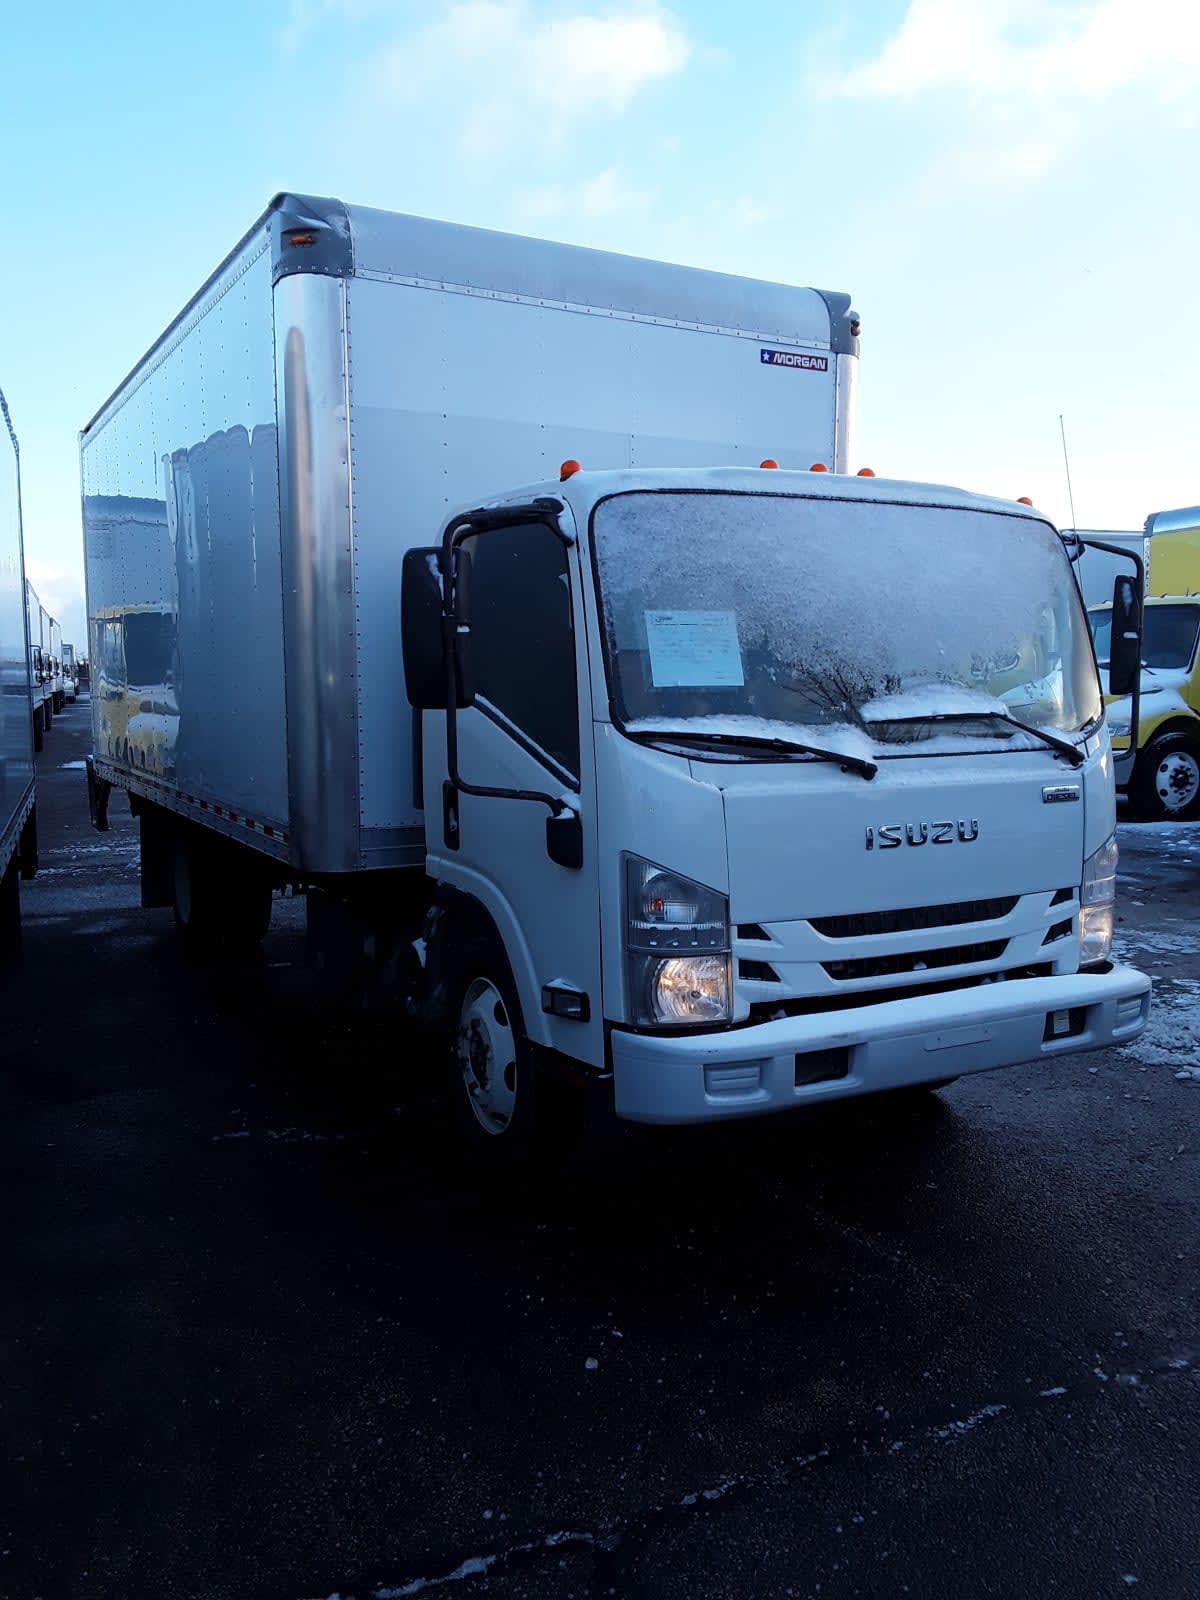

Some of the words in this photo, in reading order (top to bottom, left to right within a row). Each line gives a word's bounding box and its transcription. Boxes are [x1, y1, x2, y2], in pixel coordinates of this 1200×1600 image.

[773, 353, 826, 370] MORGAN
[1046, 792, 1079, 801] DIESEL
[865, 818, 978, 850] ISUZU
